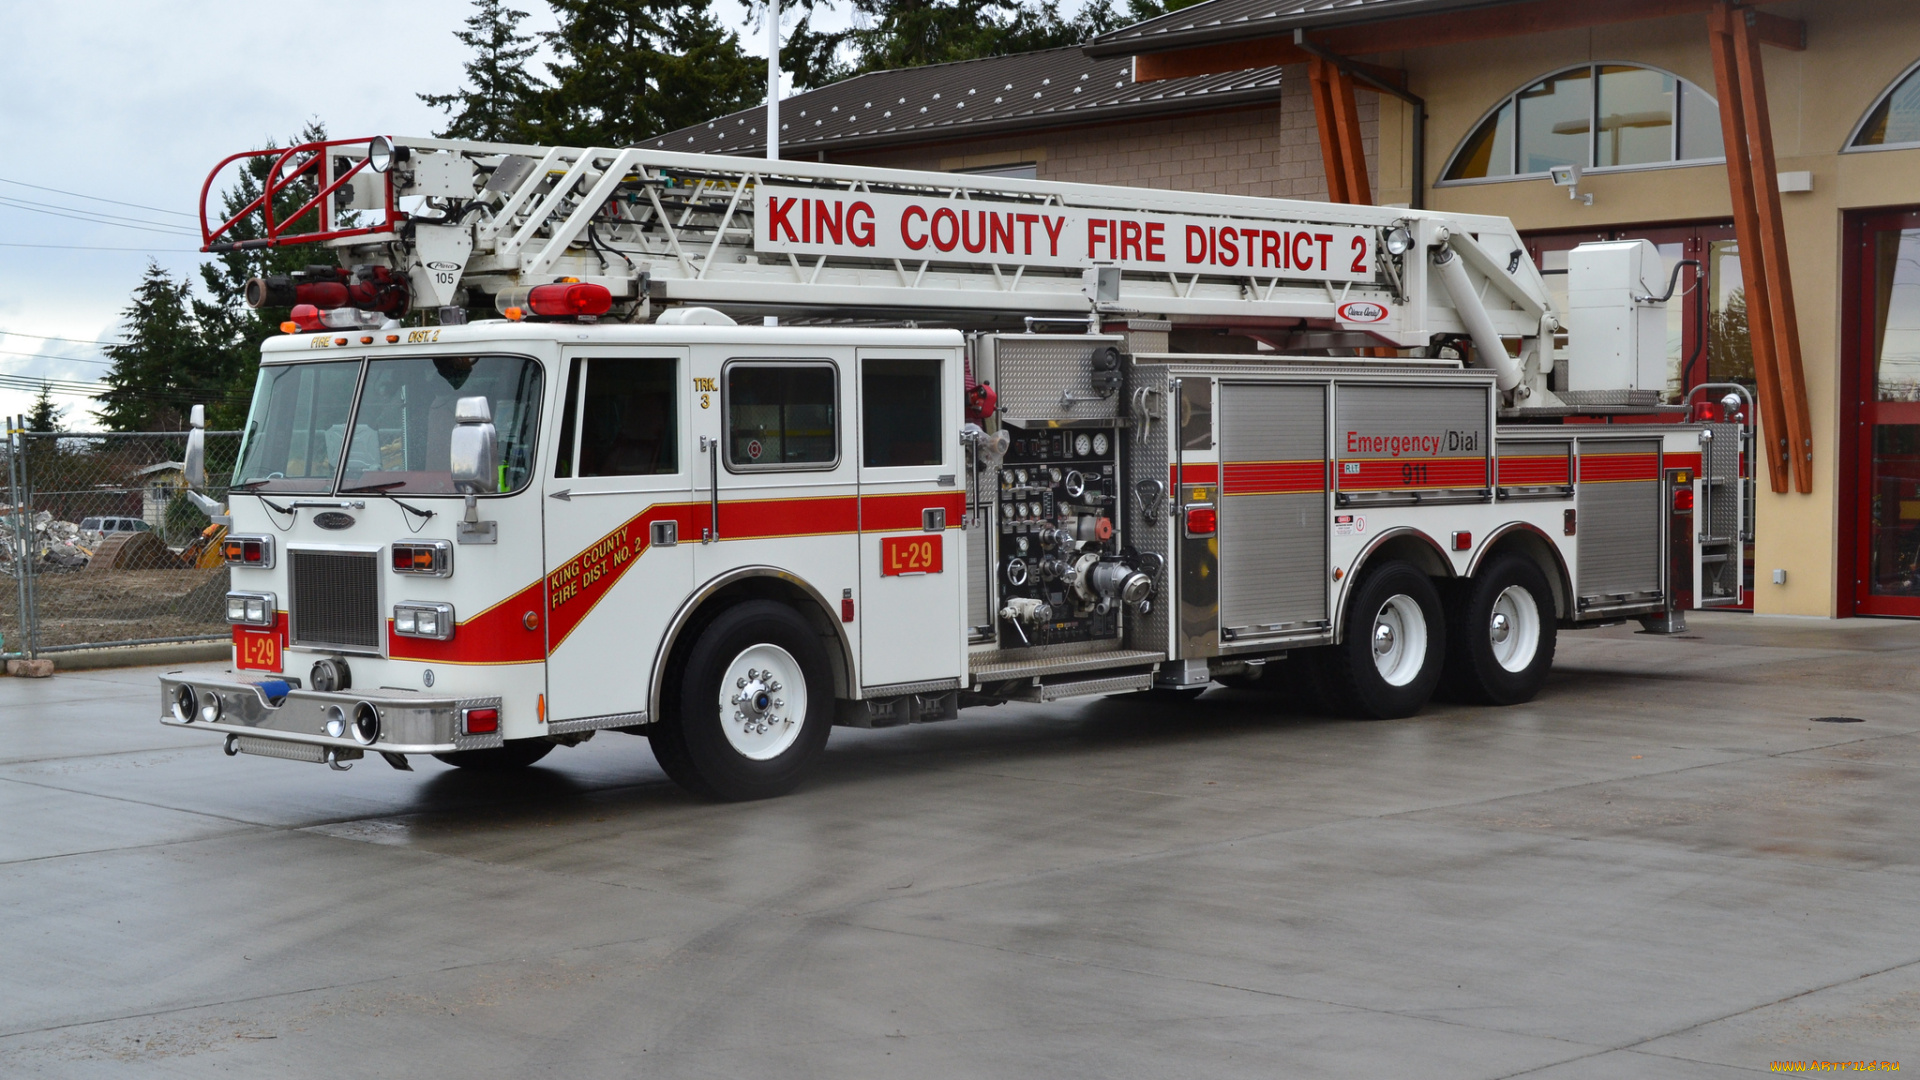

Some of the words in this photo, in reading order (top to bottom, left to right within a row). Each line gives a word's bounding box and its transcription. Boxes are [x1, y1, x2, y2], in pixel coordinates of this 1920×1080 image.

[768, 196, 876, 248] KING
[900, 204, 1066, 257] COUNTY
[1087, 217, 1166, 263] FIRE
[1185, 224, 1334, 272] DISTRICT
[1350, 234, 1368, 274] 2
[435, 272, 454, 285] 105
[310, 335, 332, 349] FIRE
[407, 329, 432, 343] DIST.
[432, 329, 441, 342] 2
[692, 377, 719, 392] TRK.
[700, 393, 710, 409] 3
[1401, 462, 1427, 485] 911
[551, 560, 580, 591] KING
[583, 526, 628, 570] COUNTY
[891, 541, 932, 569] L-29
[551, 580, 578, 610] FIRE
[582, 559, 609, 590] DIST.
[613, 545, 632, 568] NO.
[634, 537, 642, 554] 2
[244, 637, 275, 666] L-29
